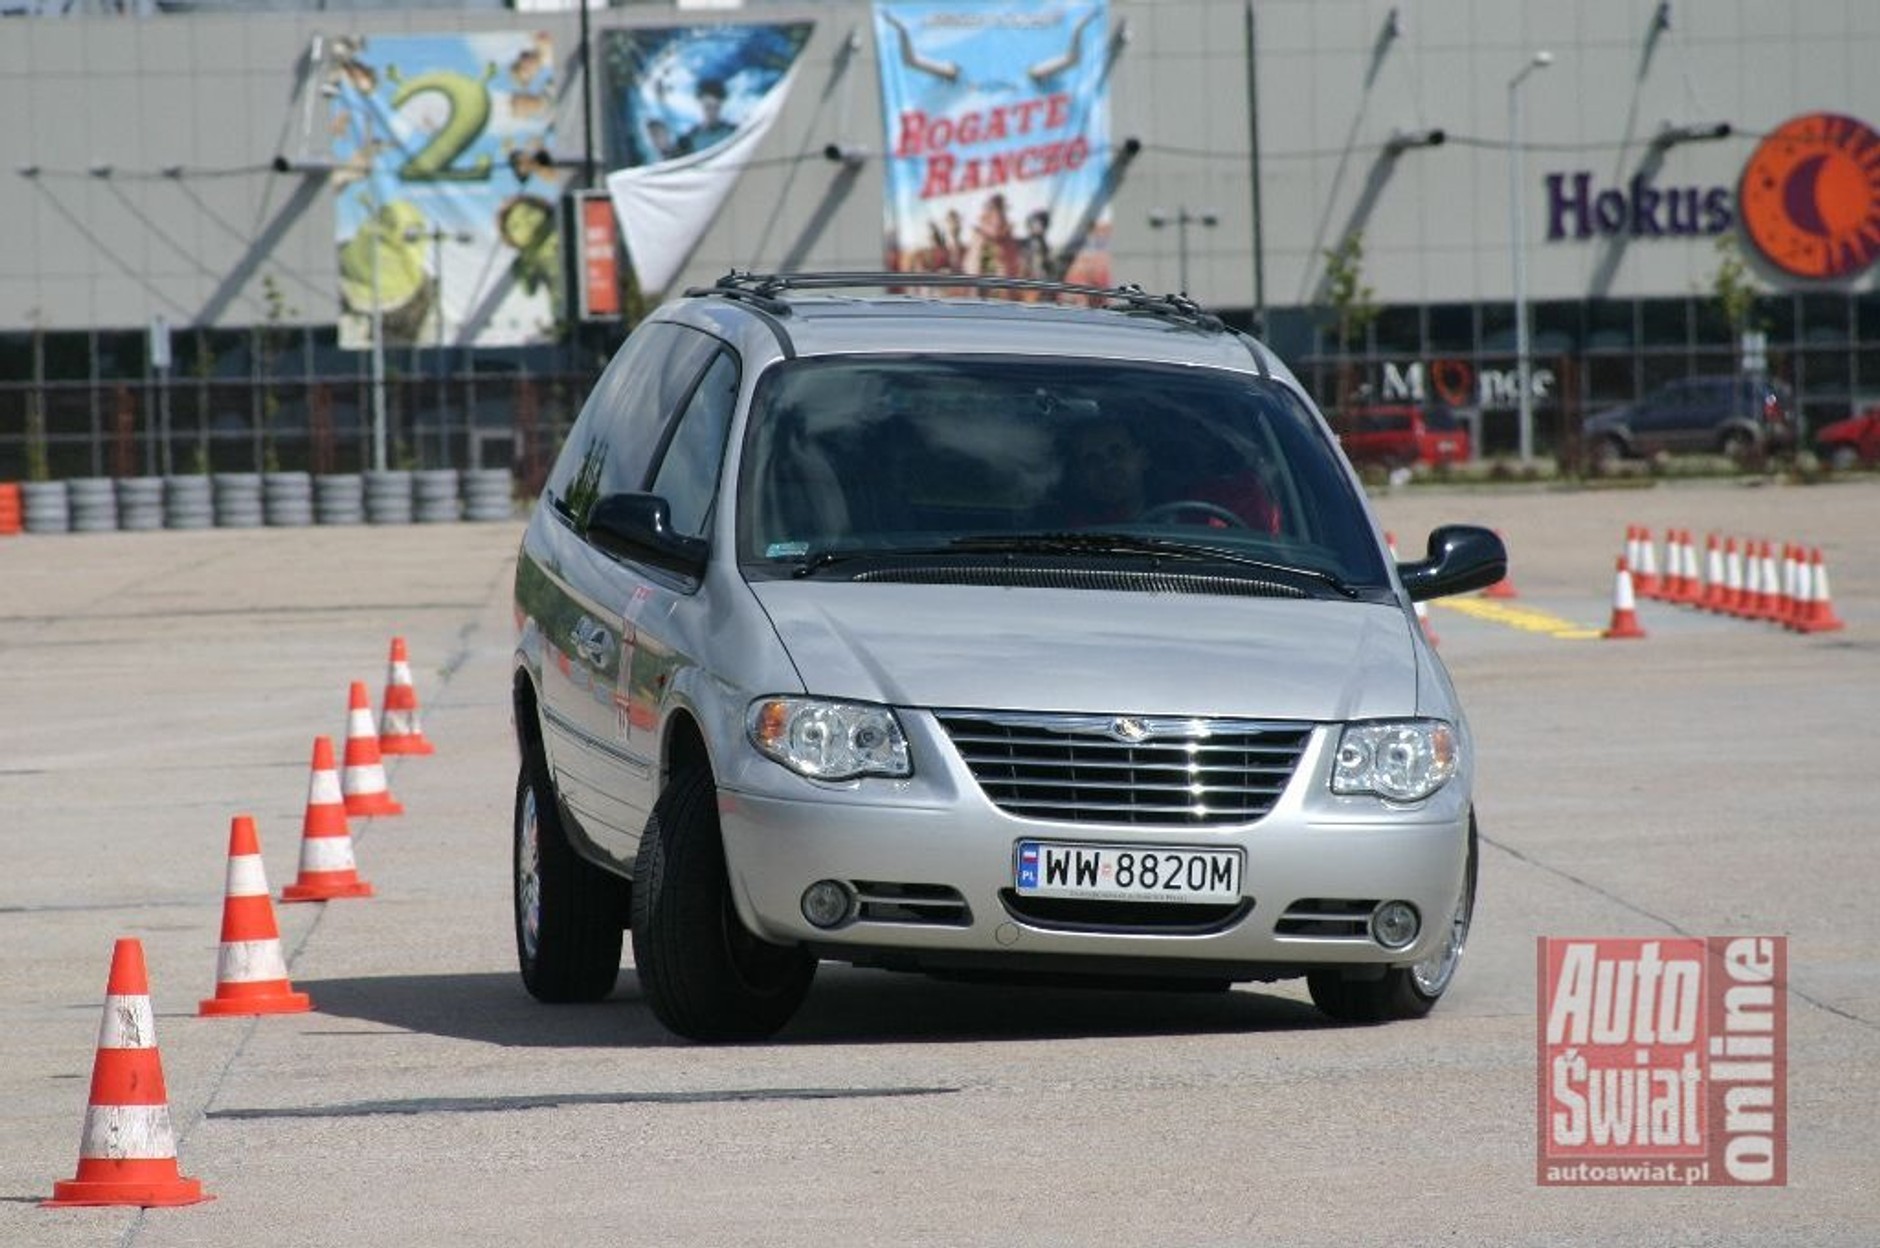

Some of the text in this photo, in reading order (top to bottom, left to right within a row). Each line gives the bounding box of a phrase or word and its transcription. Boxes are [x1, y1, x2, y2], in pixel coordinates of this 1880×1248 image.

[1546, 171, 1735, 241] Hokus
[1022, 871, 1037, 881] PL
[1045, 849, 1234, 892] WW 8820M
